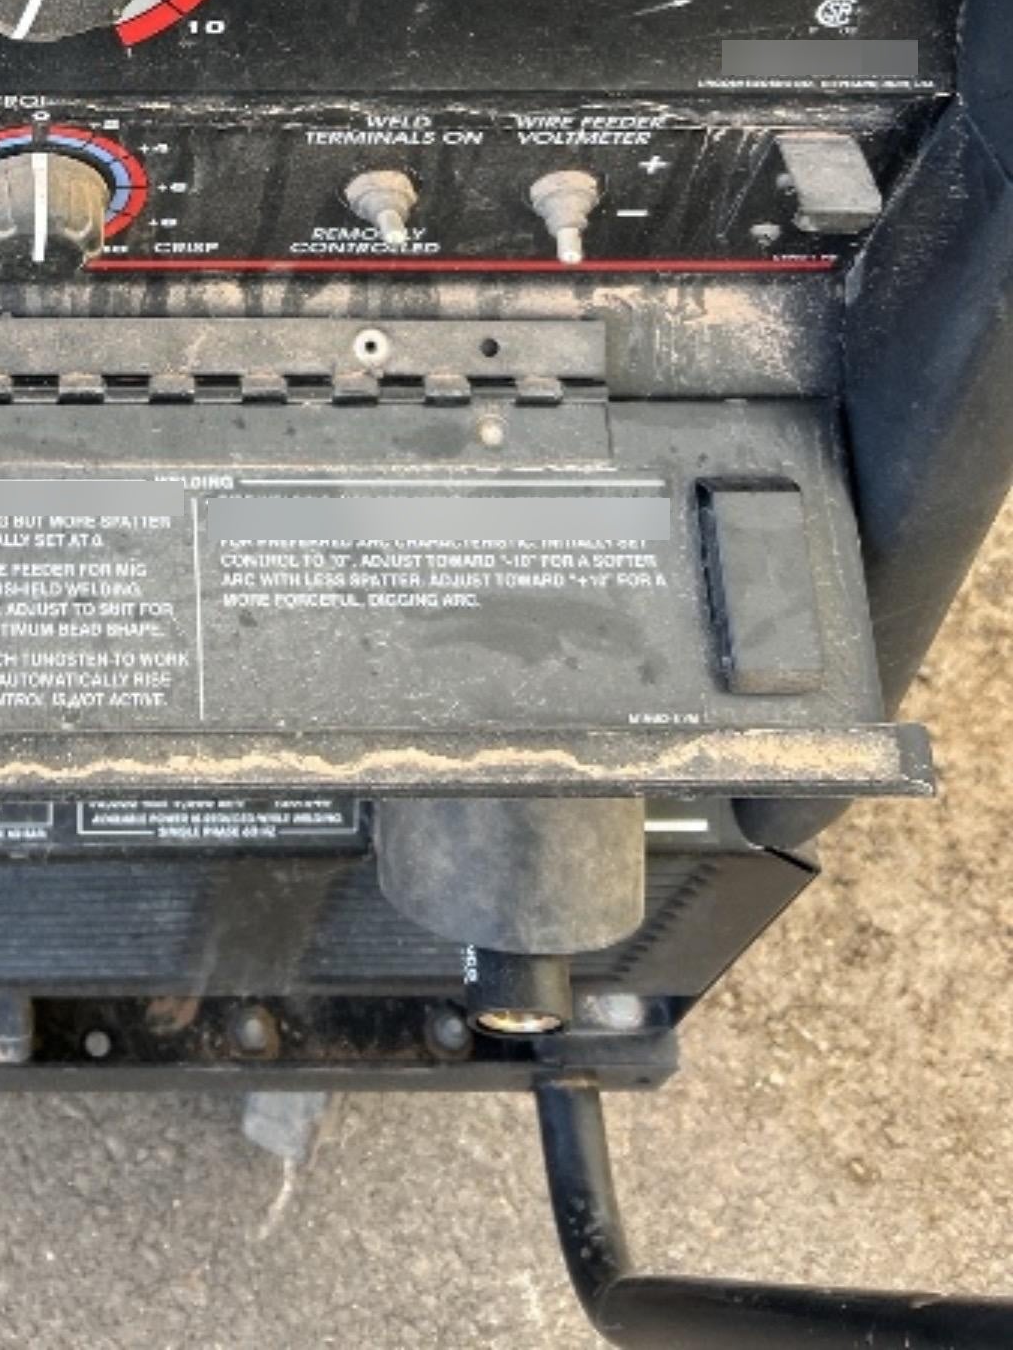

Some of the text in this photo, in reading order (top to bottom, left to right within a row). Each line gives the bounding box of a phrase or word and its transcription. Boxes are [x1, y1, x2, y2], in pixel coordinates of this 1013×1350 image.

[188, 19, 226, 34] 10
[364, 116, 433, 129] WELD
[514, 116, 666, 129] WIRE FEEDER
[305, 131, 485, 145] TERMINALS ON
[516, 131, 652, 145] VOLTMETER
[311, 227, 427, 241] REMOY
[153, 242, 218, 254] CRISP
[11, 563, 76, 577] FEEDER
[7, 602, 69, 616] ADJUST
[72, 602, 96, 616] TO
